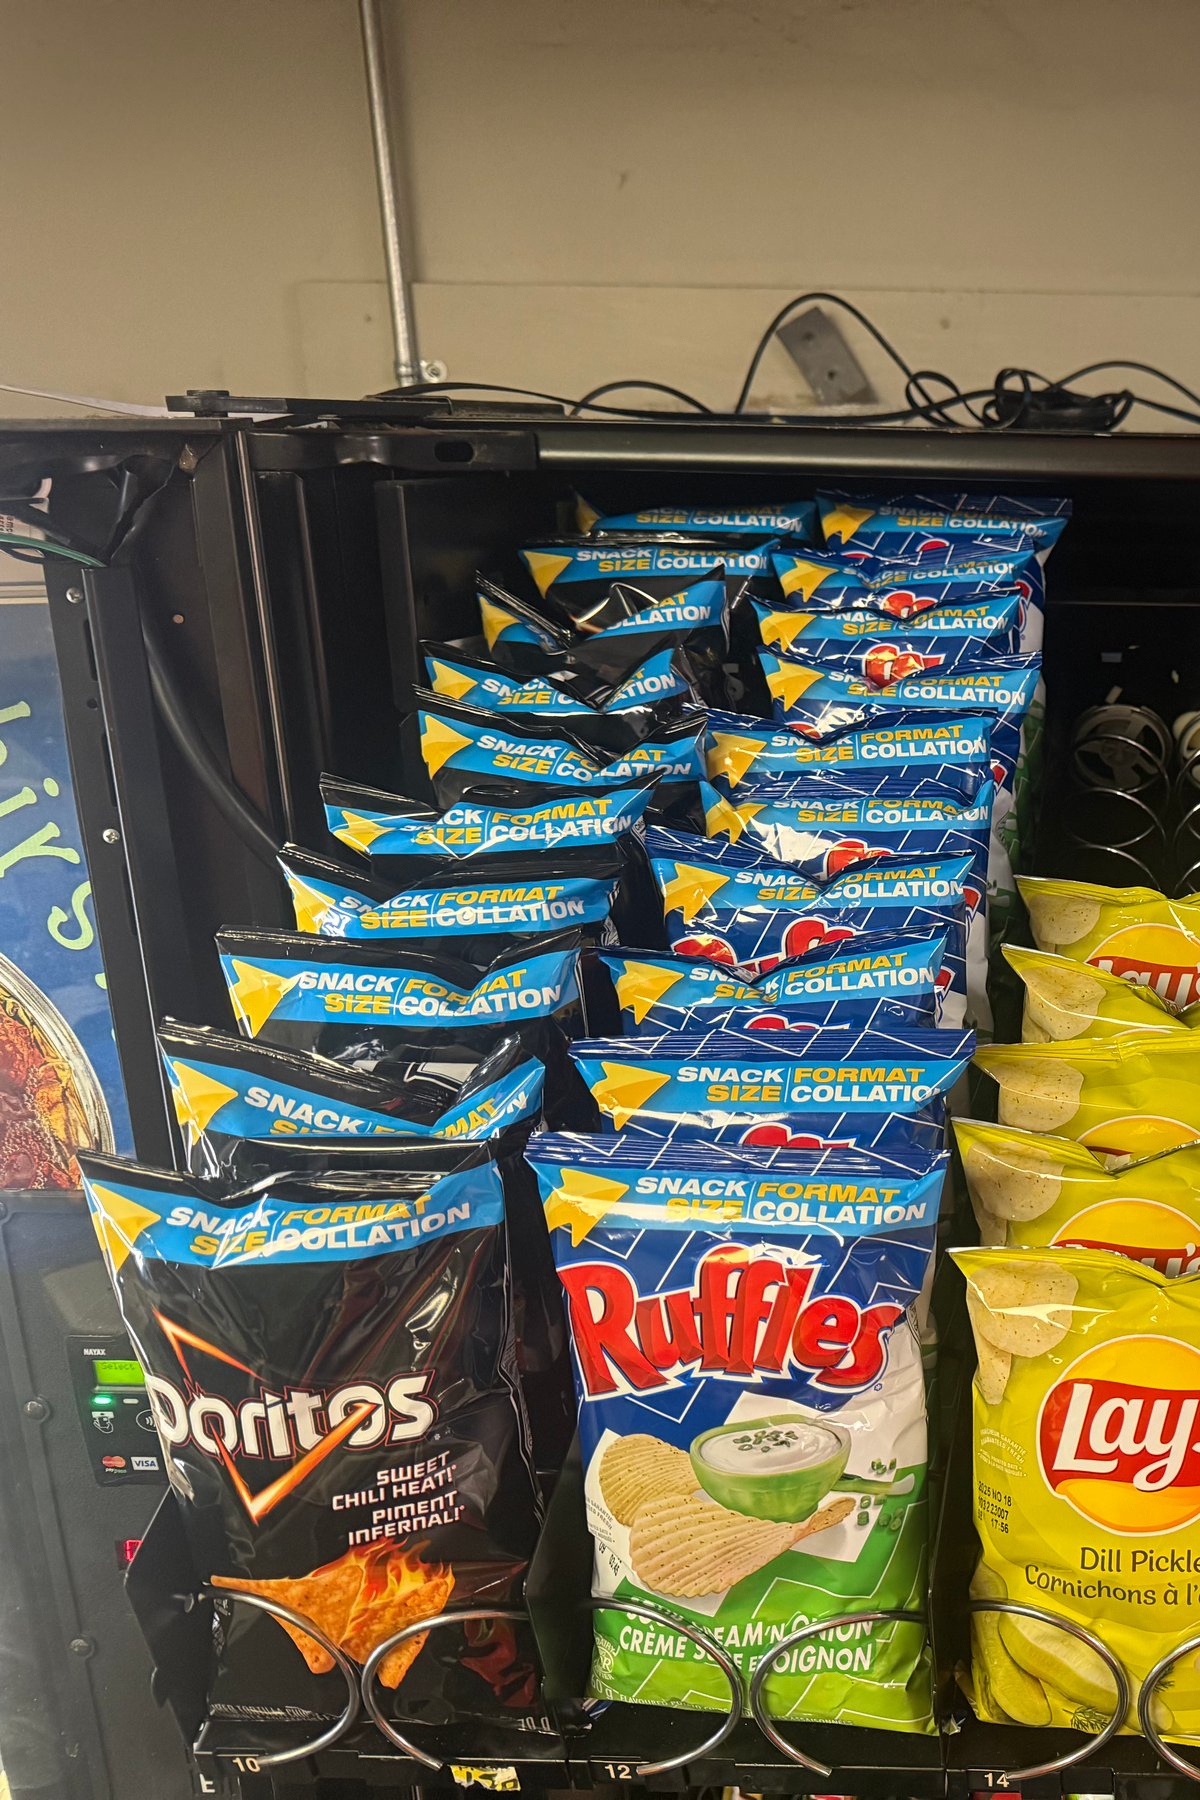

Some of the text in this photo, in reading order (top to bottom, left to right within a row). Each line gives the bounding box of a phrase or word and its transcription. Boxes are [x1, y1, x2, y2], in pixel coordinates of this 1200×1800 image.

[636, 513, 802, 532] SIZE COLLATION
[897, 516, 945, 527] SIZE
[576, 550, 652, 561] SNACK
[598, 560, 650, 572] SIZE
[843, 622, 892, 636] SIZE
[906, 676, 1004, 687] FORMAT
[498, 691, 552, 705] SIZE
[904, 686, 1026, 705] COLLATION
[860, 725, 964, 743] FORMAT
[477, 735, 558, 758] SNACK
[796, 738, 987, 763] SIZE COLLATION
[492, 754, 553, 775] SIZE
[491, 799, 612, 826] FORMAT
[773, 799, 859, 811] SNACK
[797, 809, 859, 823] SIZE
[415, 827, 482, 845] SIZE
[489, 815, 632, 842] COLLATION
[438, 885, 564, 906] FORMAT
[756, 880, 964, 901] SIZE COLLATION
[360, 899, 585, 929] SIZE COLLATION
[788, 952, 908, 983] FORMAT
[298, 971, 399, 993] SNACK
[783, 967, 936, 996] COLLATION
[324, 993, 392, 1015] SIZE
[676, 1066, 925, 1084] SNACK FORMAT
[706, 1084, 781, 1103] SIZE
[244, 1086, 364, 1135] SNACK
[634, 1176, 900, 1204] SNACK FORMAT
[165, 1194, 432, 1229] SNACK FORMAT
[666, 1197, 927, 1226] SIZE COLLATION
[189, 1202, 471, 1256] SIZE COLLATION
[557, 1245, 904, 1400] Ruffles
[147, 1374, 438, 1459] Doritos
[134, 1460, 157, 1468] VISA
[376, 1450, 450, 1486] SWEET
[332, 1466, 455, 1511] CHILI HEAT!
[372, 1490, 458, 1525] PIMENT
[1003, 1495, 1012, 1507] 18
[348, 1506, 462, 1546] INFERNAL!
[1080, 1546, 1122, 1573] Dill
[1024, 1563, 1157, 1606] Cornichons
[1163, 1583, 1179, 1606] à
[620, 1624, 873, 1674] CRÈME OIGNON
[231, 1756, 261, 1774] 10
[603, 1763, 634, 1781] 12
[983, 1772, 1010, 1788] 14
